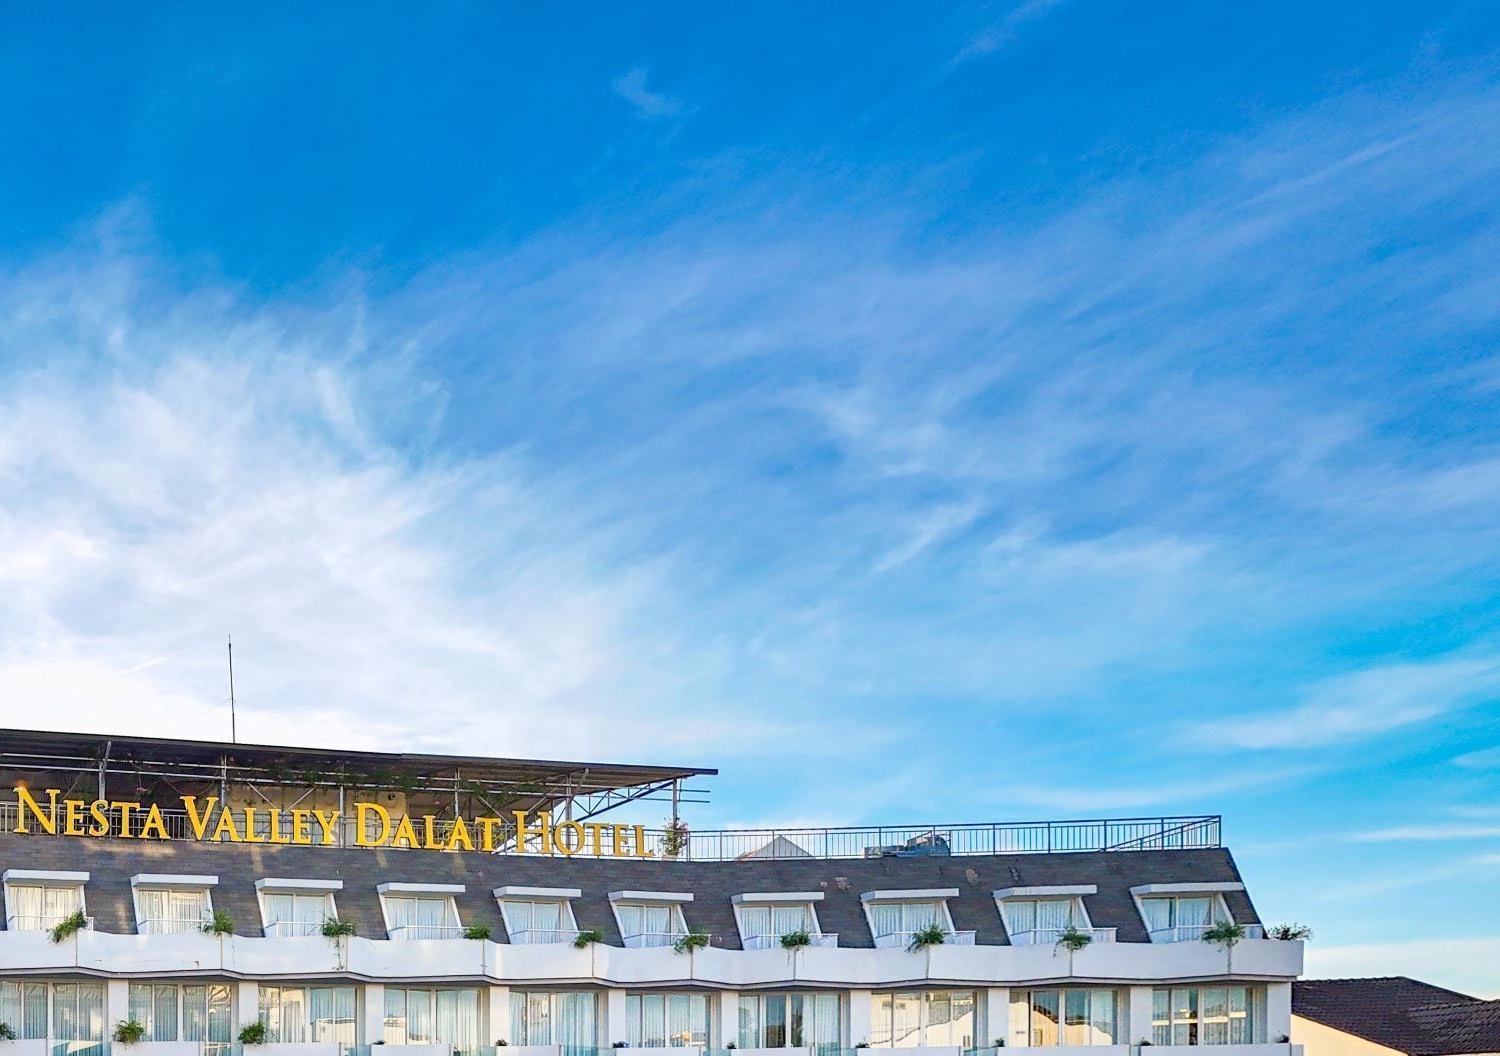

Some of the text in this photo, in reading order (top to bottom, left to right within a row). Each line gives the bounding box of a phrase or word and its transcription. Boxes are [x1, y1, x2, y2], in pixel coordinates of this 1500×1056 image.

[13, 786, 653, 857] NESTA VALLEY DALAT HOTEL
